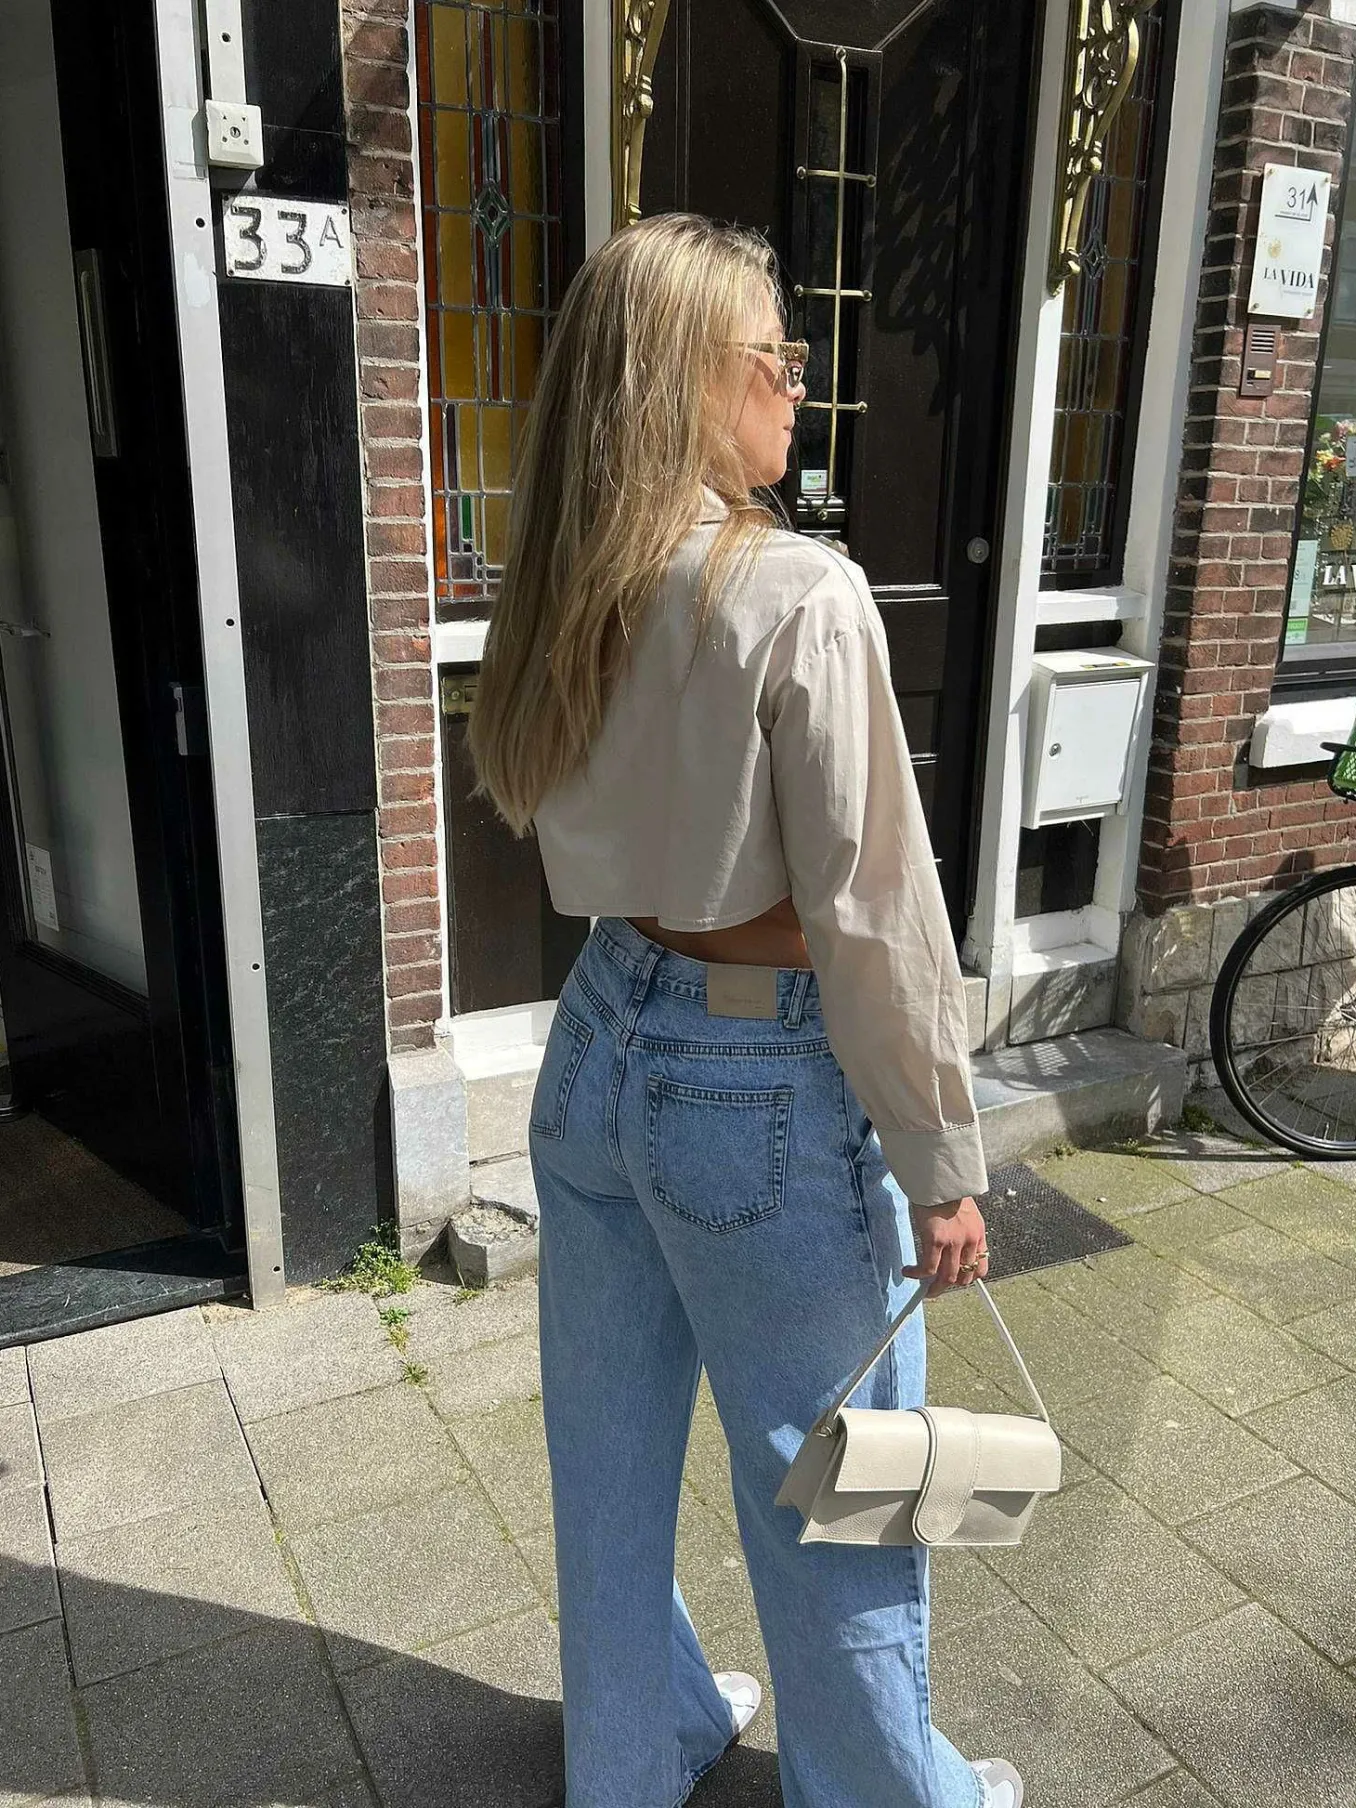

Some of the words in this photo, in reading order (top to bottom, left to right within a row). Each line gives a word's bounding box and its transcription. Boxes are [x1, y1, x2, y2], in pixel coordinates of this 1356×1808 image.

[1287, 186, 1306, 210] 31
[1263, 267, 1277, 280] LA
[1280, 269, 1314, 289] VIDA
[1322, 565, 1346, 585] LA
